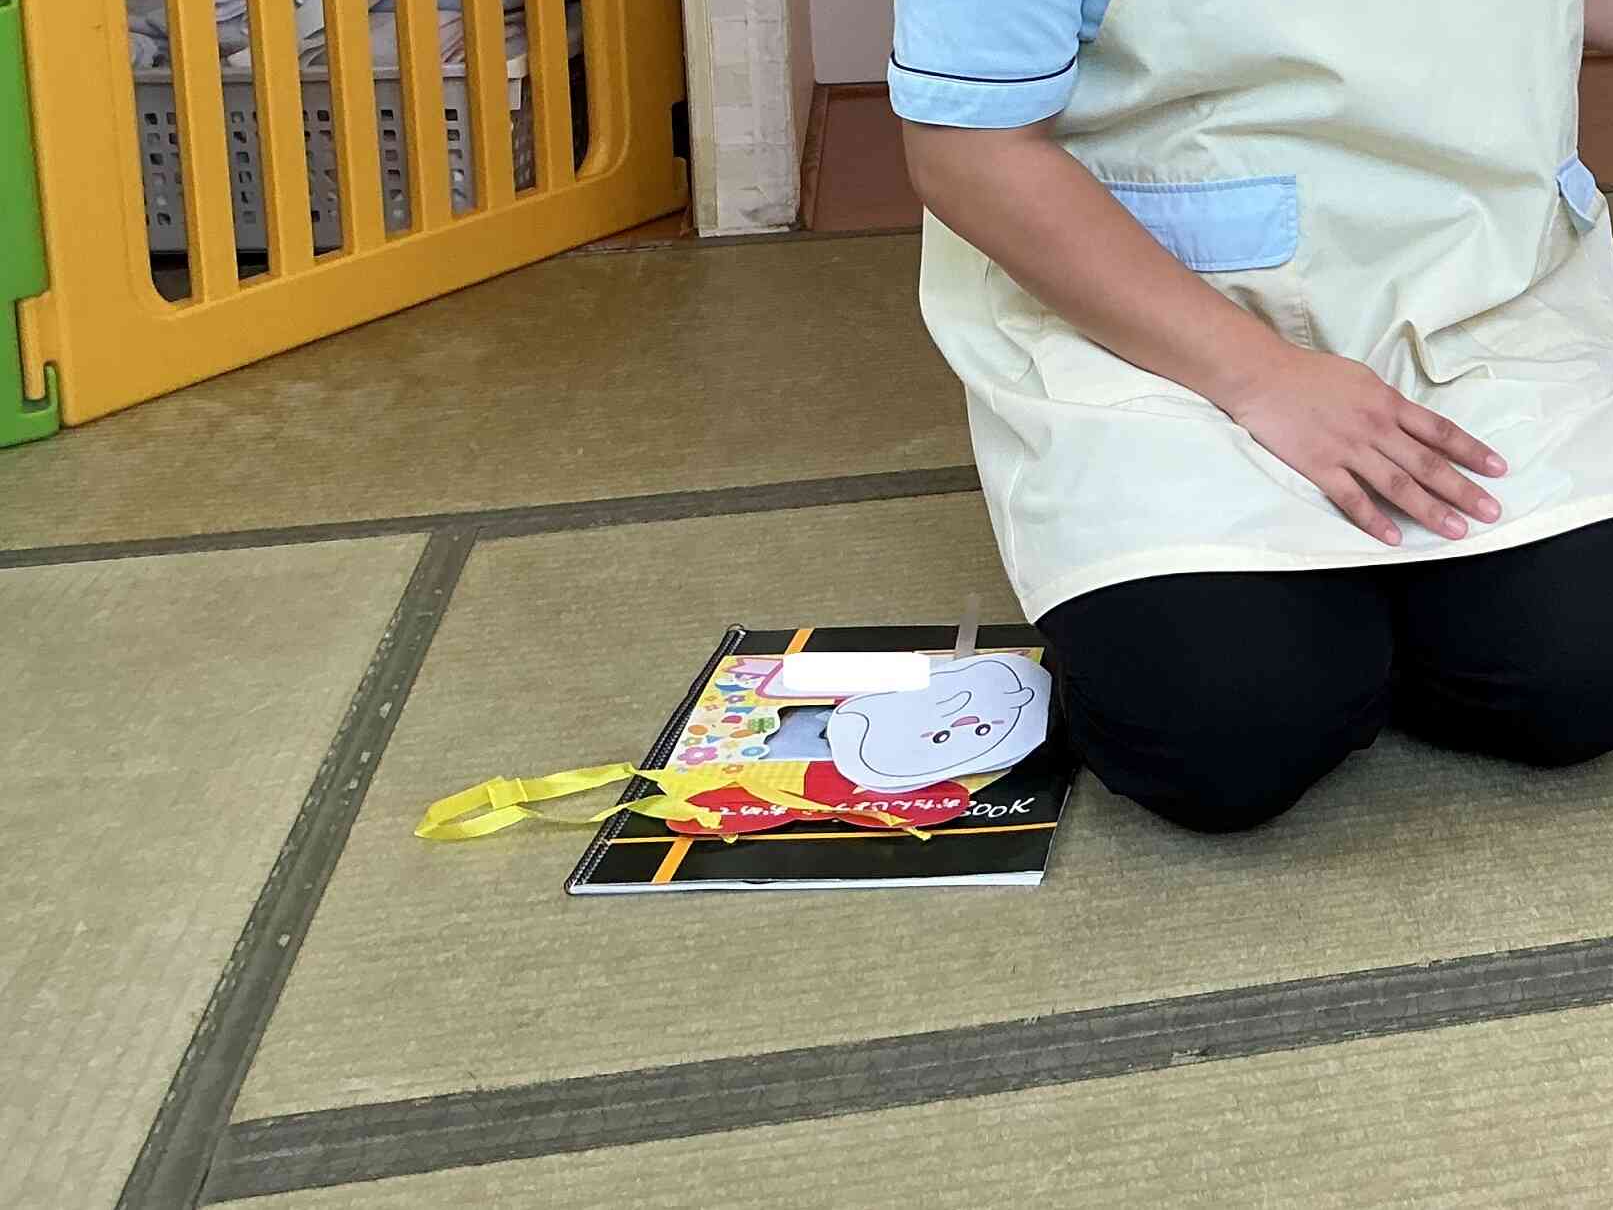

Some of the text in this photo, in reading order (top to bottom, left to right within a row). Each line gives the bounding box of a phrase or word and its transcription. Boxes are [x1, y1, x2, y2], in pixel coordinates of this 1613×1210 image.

[801, 797, 961, 816] おたんじょう
